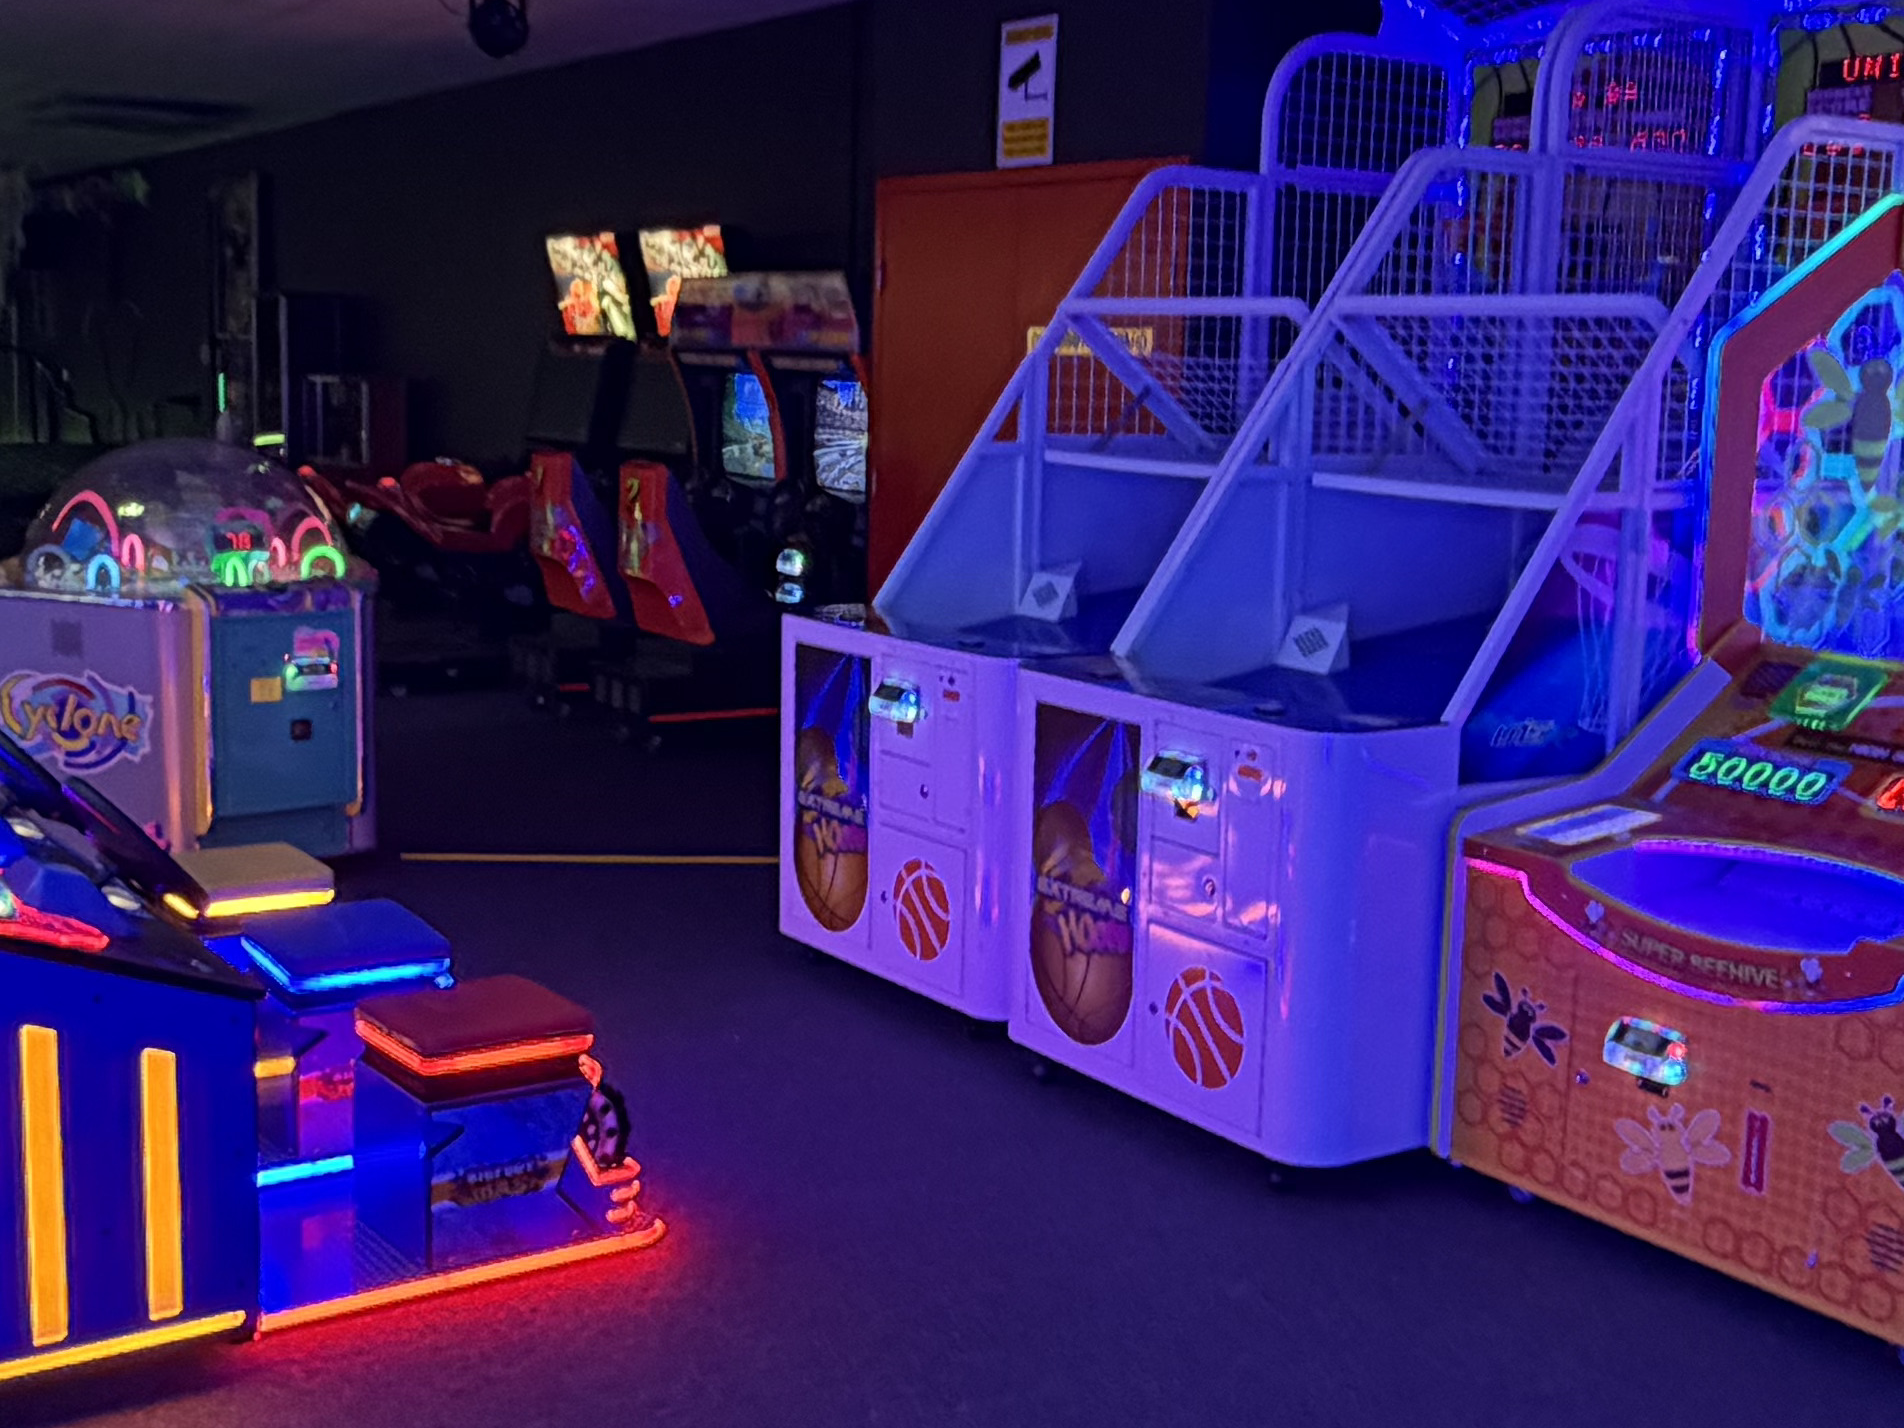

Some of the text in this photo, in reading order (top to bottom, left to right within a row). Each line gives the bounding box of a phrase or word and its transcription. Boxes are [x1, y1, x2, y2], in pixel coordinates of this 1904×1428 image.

[1689, 751, 1827, 801] 50000
[1621, 928, 1780, 989] SUPER BEEHIVE
